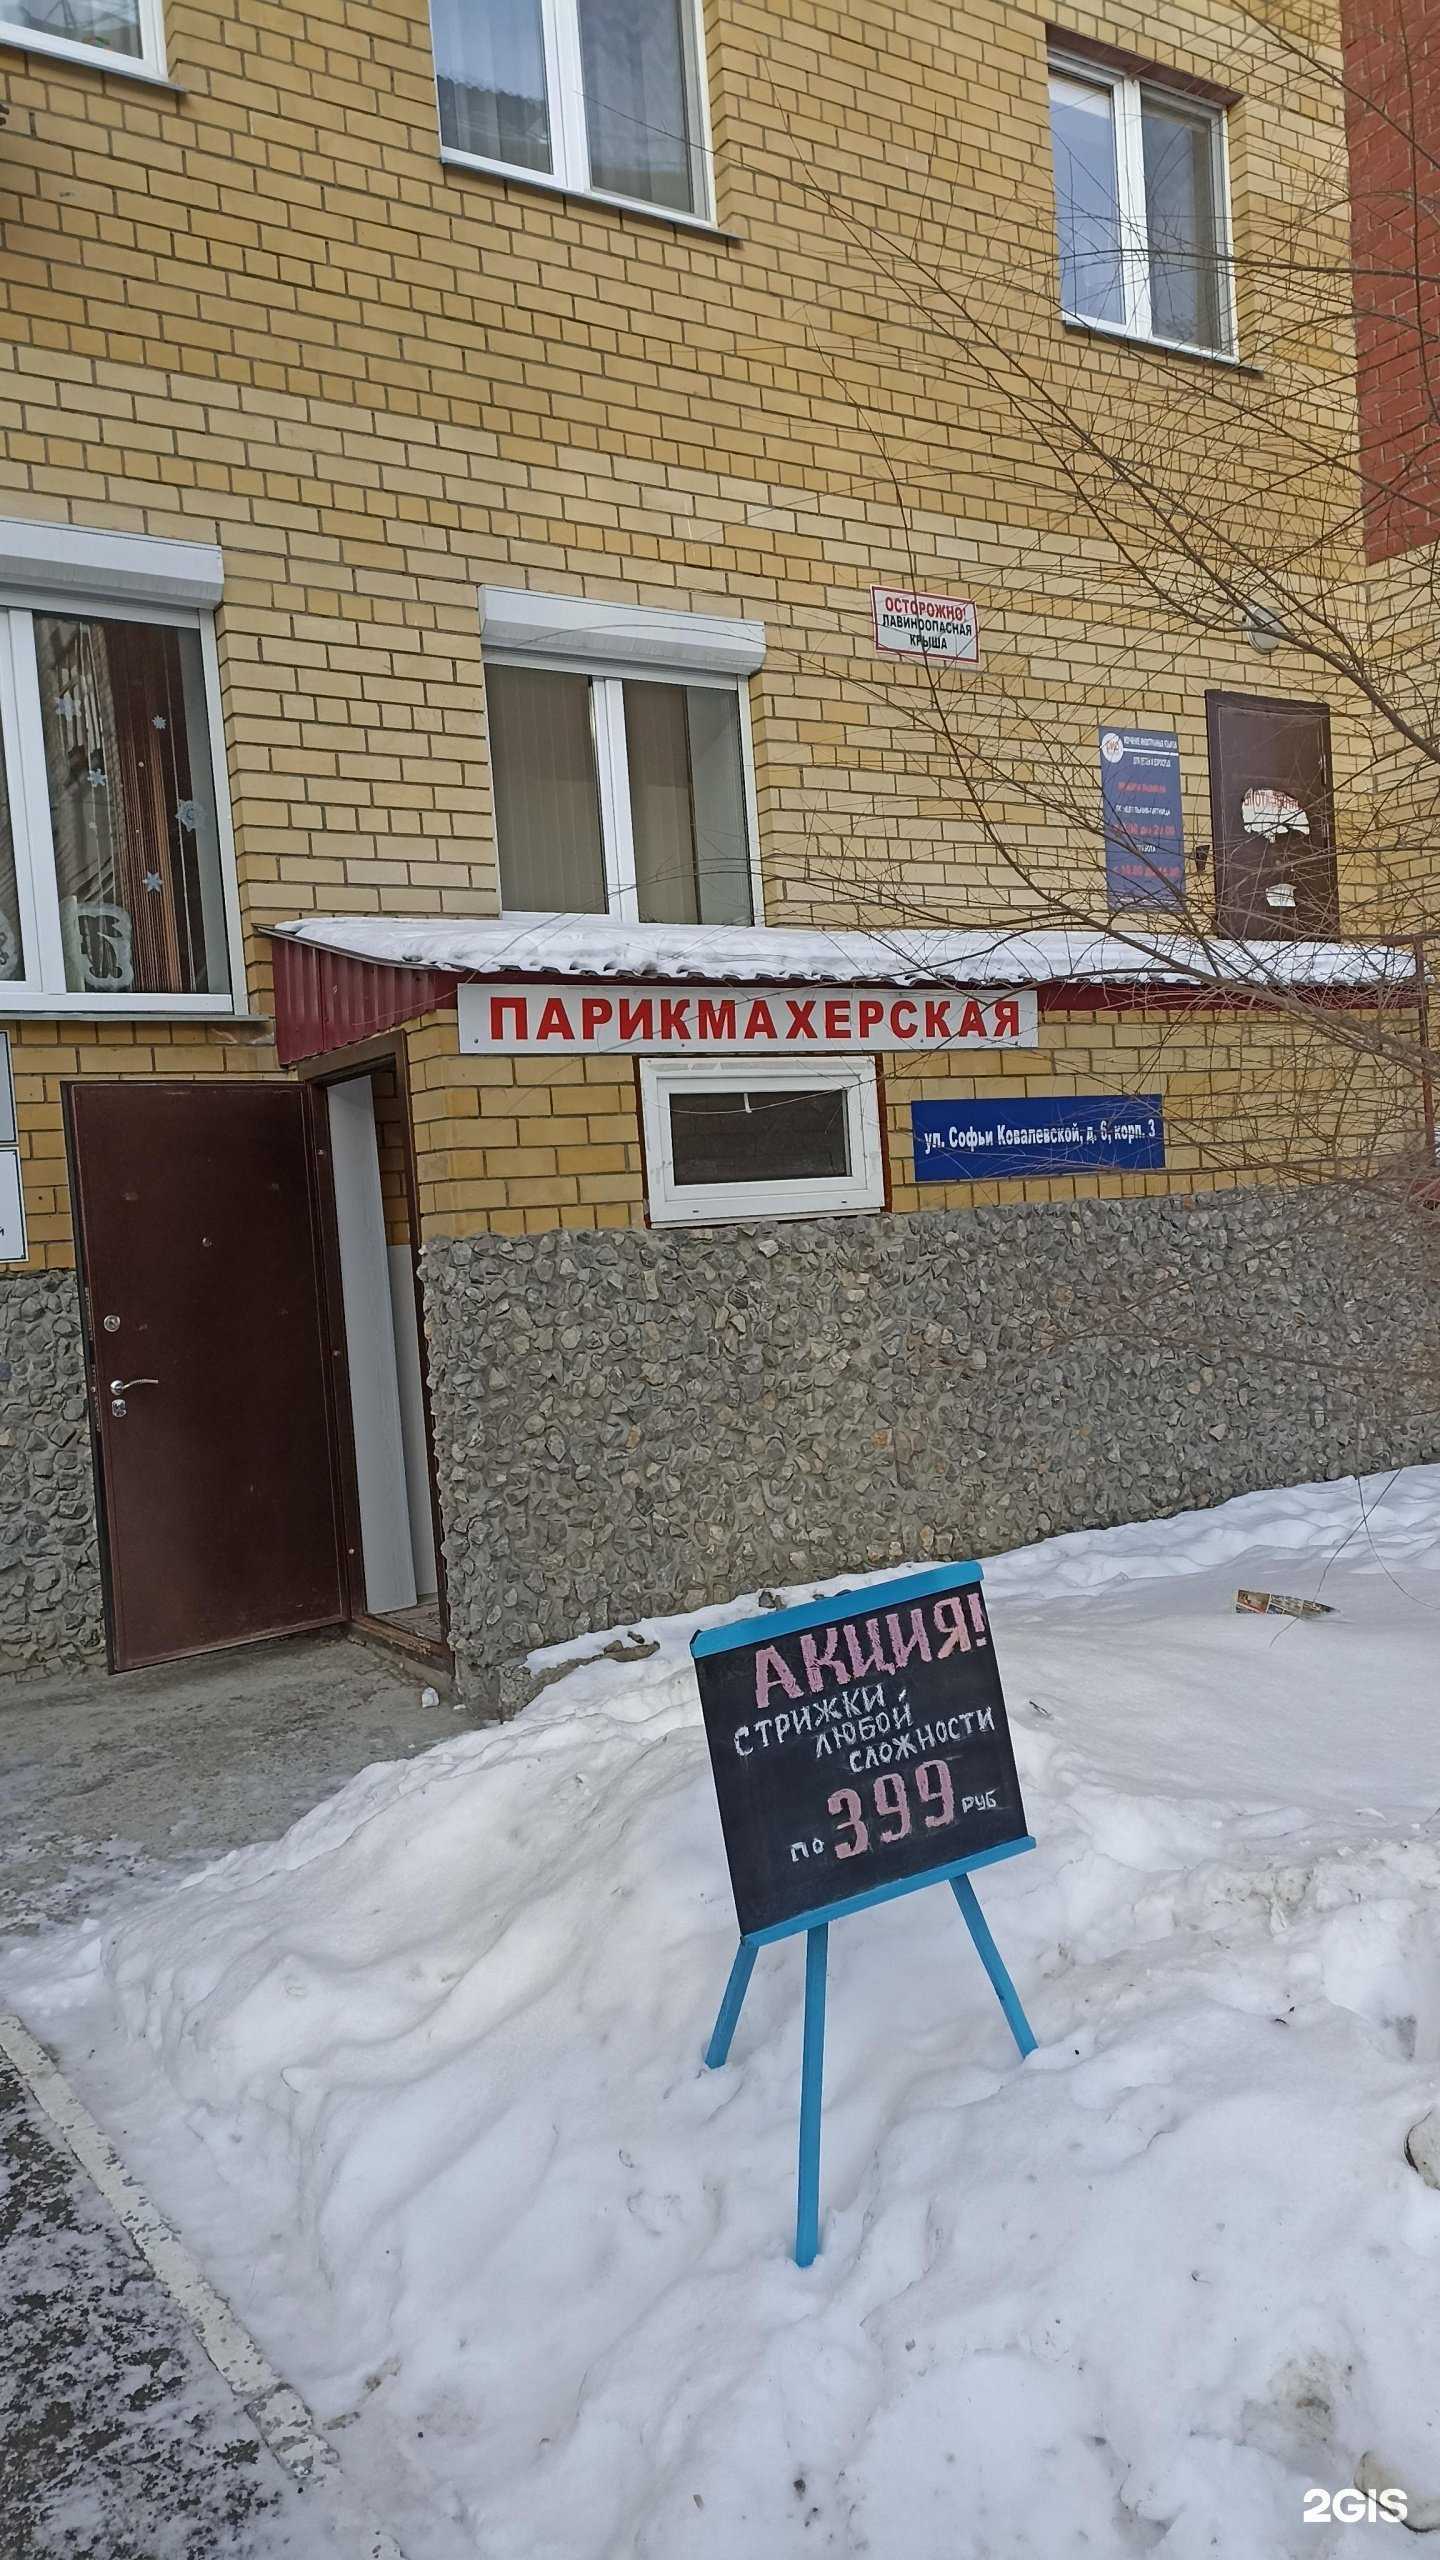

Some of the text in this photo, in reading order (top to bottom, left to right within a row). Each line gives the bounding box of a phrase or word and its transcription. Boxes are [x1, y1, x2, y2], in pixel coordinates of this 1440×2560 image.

[882, 614, 972, 636] ЛАВИНООПАСНАЯ
[885, 596, 966, 621] ОСТОРОЖНО!
[909, 634, 947, 649] КРЫША
[489, 996, 1020, 1041] ПАРИКМАХЕРСКАЯ
[924, 1119, 1156, 1154] ул. Софьи Ковалевской, д. 6, корп. 3
[755, 1593, 987, 1709] АКЦИЯ!
[734, 1684, 886, 1757] СТРИЖКИ
[815, 1688, 913, 1759] ЛЮБОЙ
[849, 1706, 996, 1773] СЛОЖНОСТИ
[827, 1759, 955, 1860] 399
